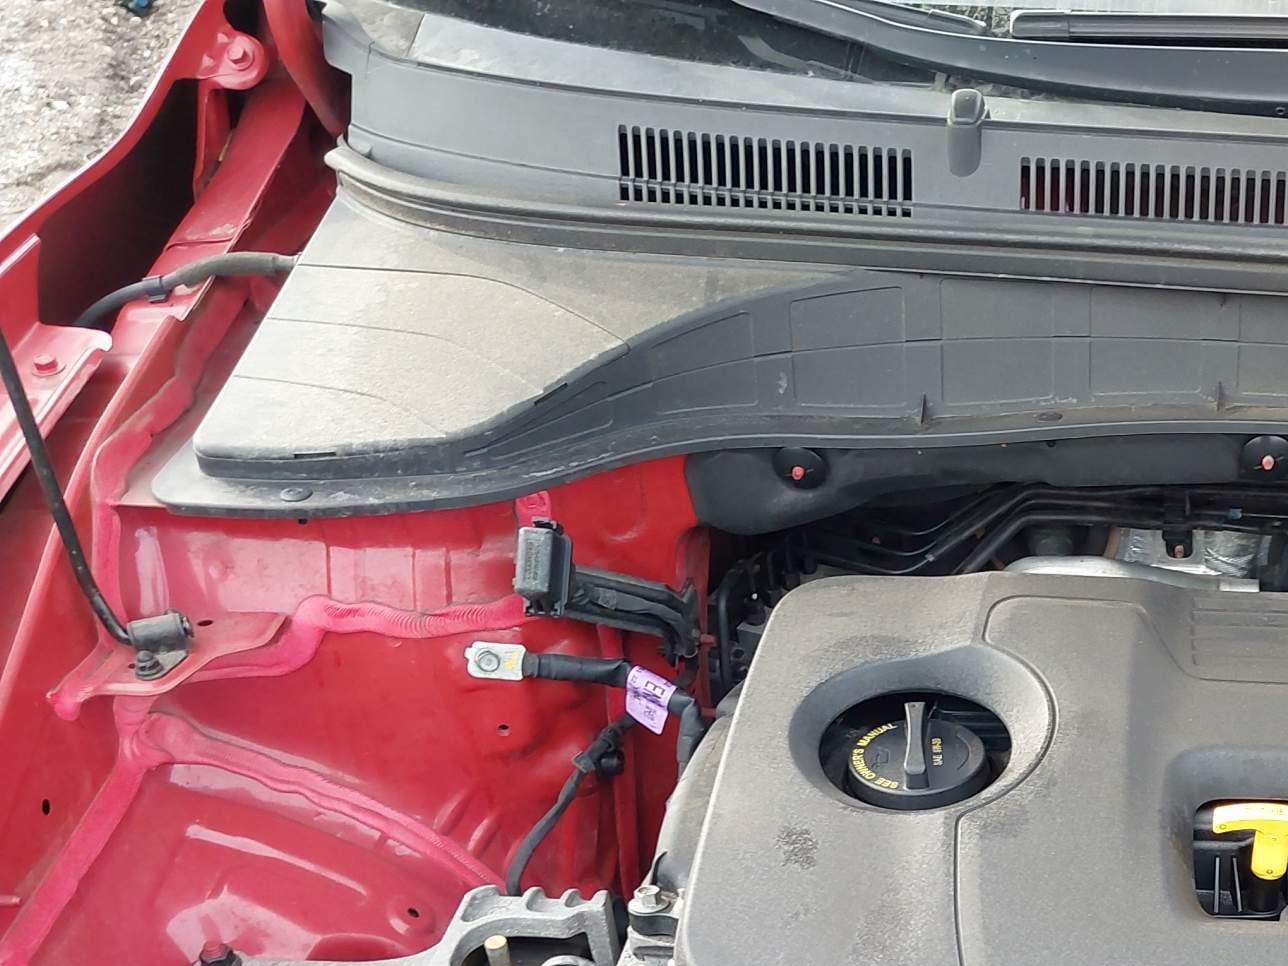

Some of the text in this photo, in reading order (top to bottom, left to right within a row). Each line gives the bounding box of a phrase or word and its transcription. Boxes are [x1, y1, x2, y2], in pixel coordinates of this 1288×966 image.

[852, 723, 899, 789] SEE OWNER'S MANUAL
